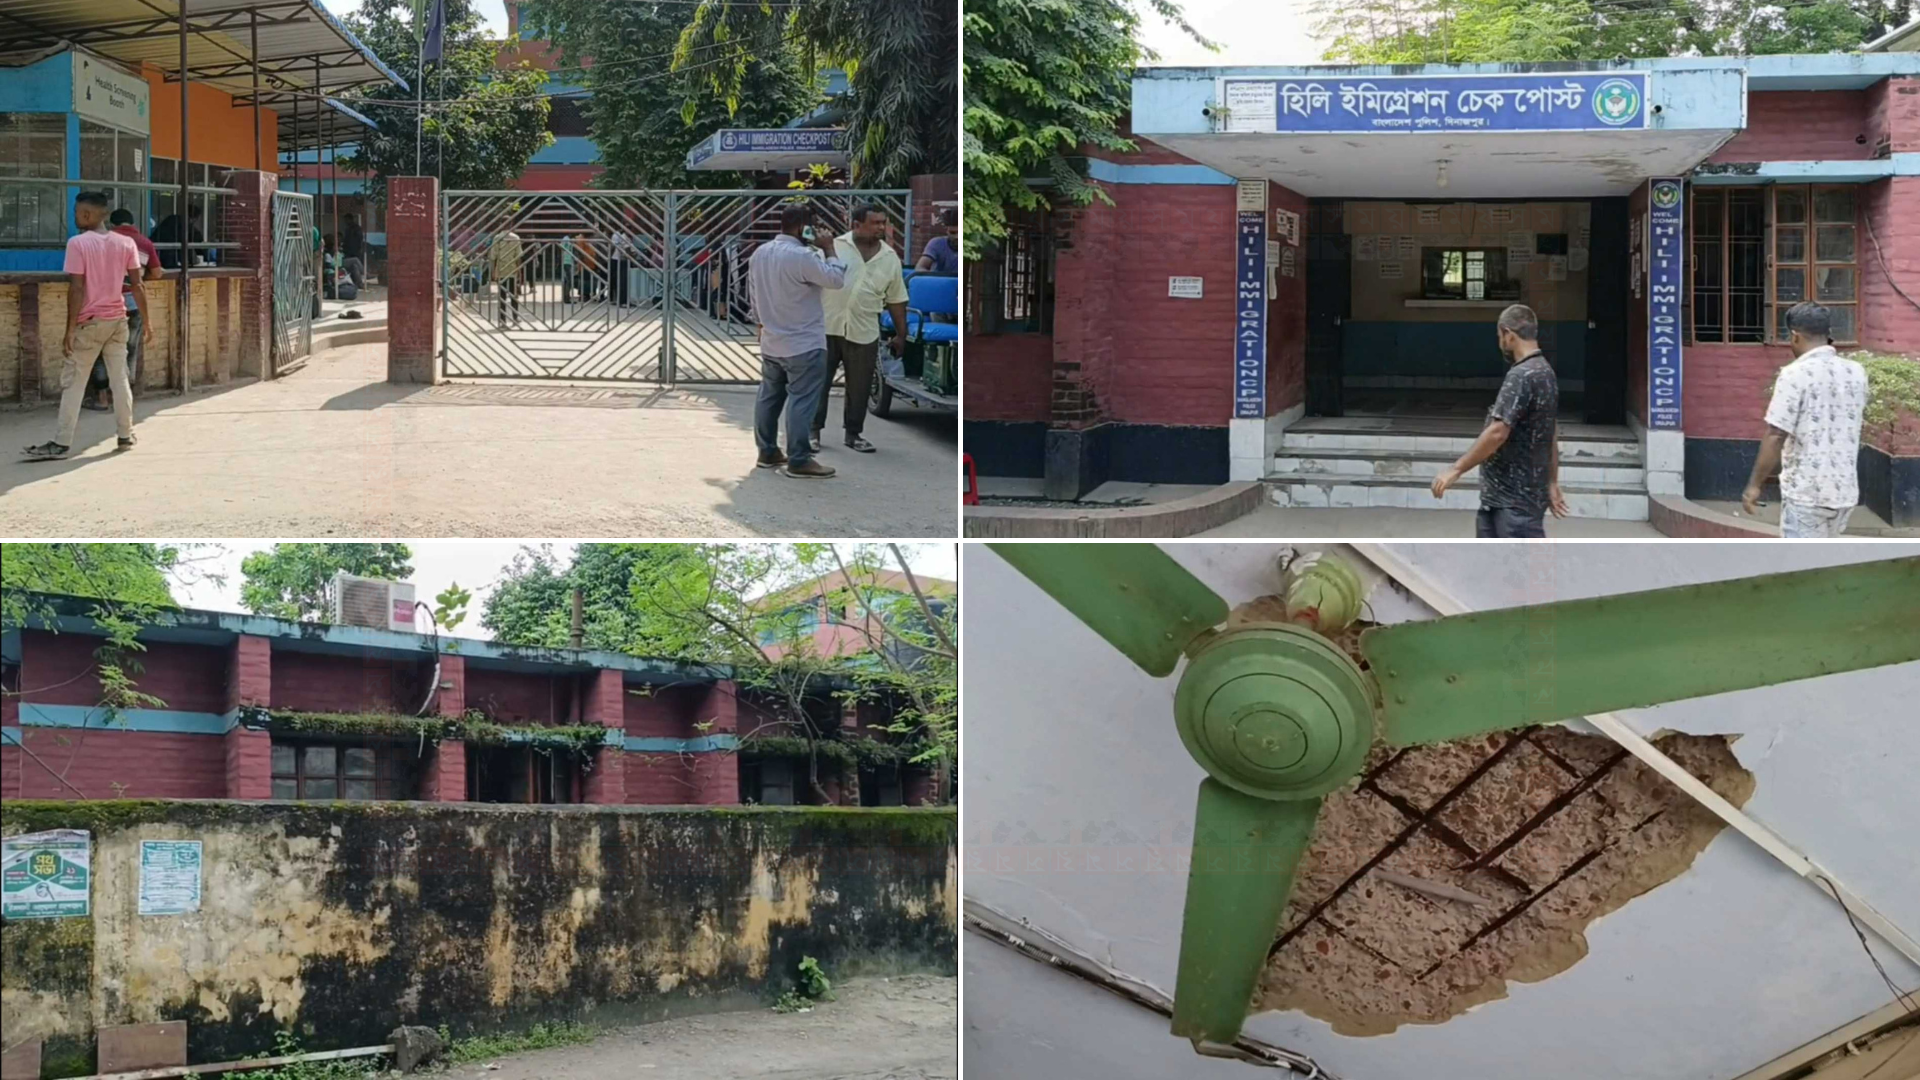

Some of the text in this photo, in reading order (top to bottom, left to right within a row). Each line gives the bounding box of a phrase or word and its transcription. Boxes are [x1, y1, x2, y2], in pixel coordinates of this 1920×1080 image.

[95, 75, 136, 105] Health Screening
[109, 94, 125, 109] Booth
[1280, 79, 1586, 118] হিলি ইমিগ্রেশন চেক পোস্ট
[1371, 117, 1412, 127] বাংলাদেশ
[738, 132, 831, 145] HILI IMMIGRATION CHECKPOST
[33, 864, 56, 875] সভা
